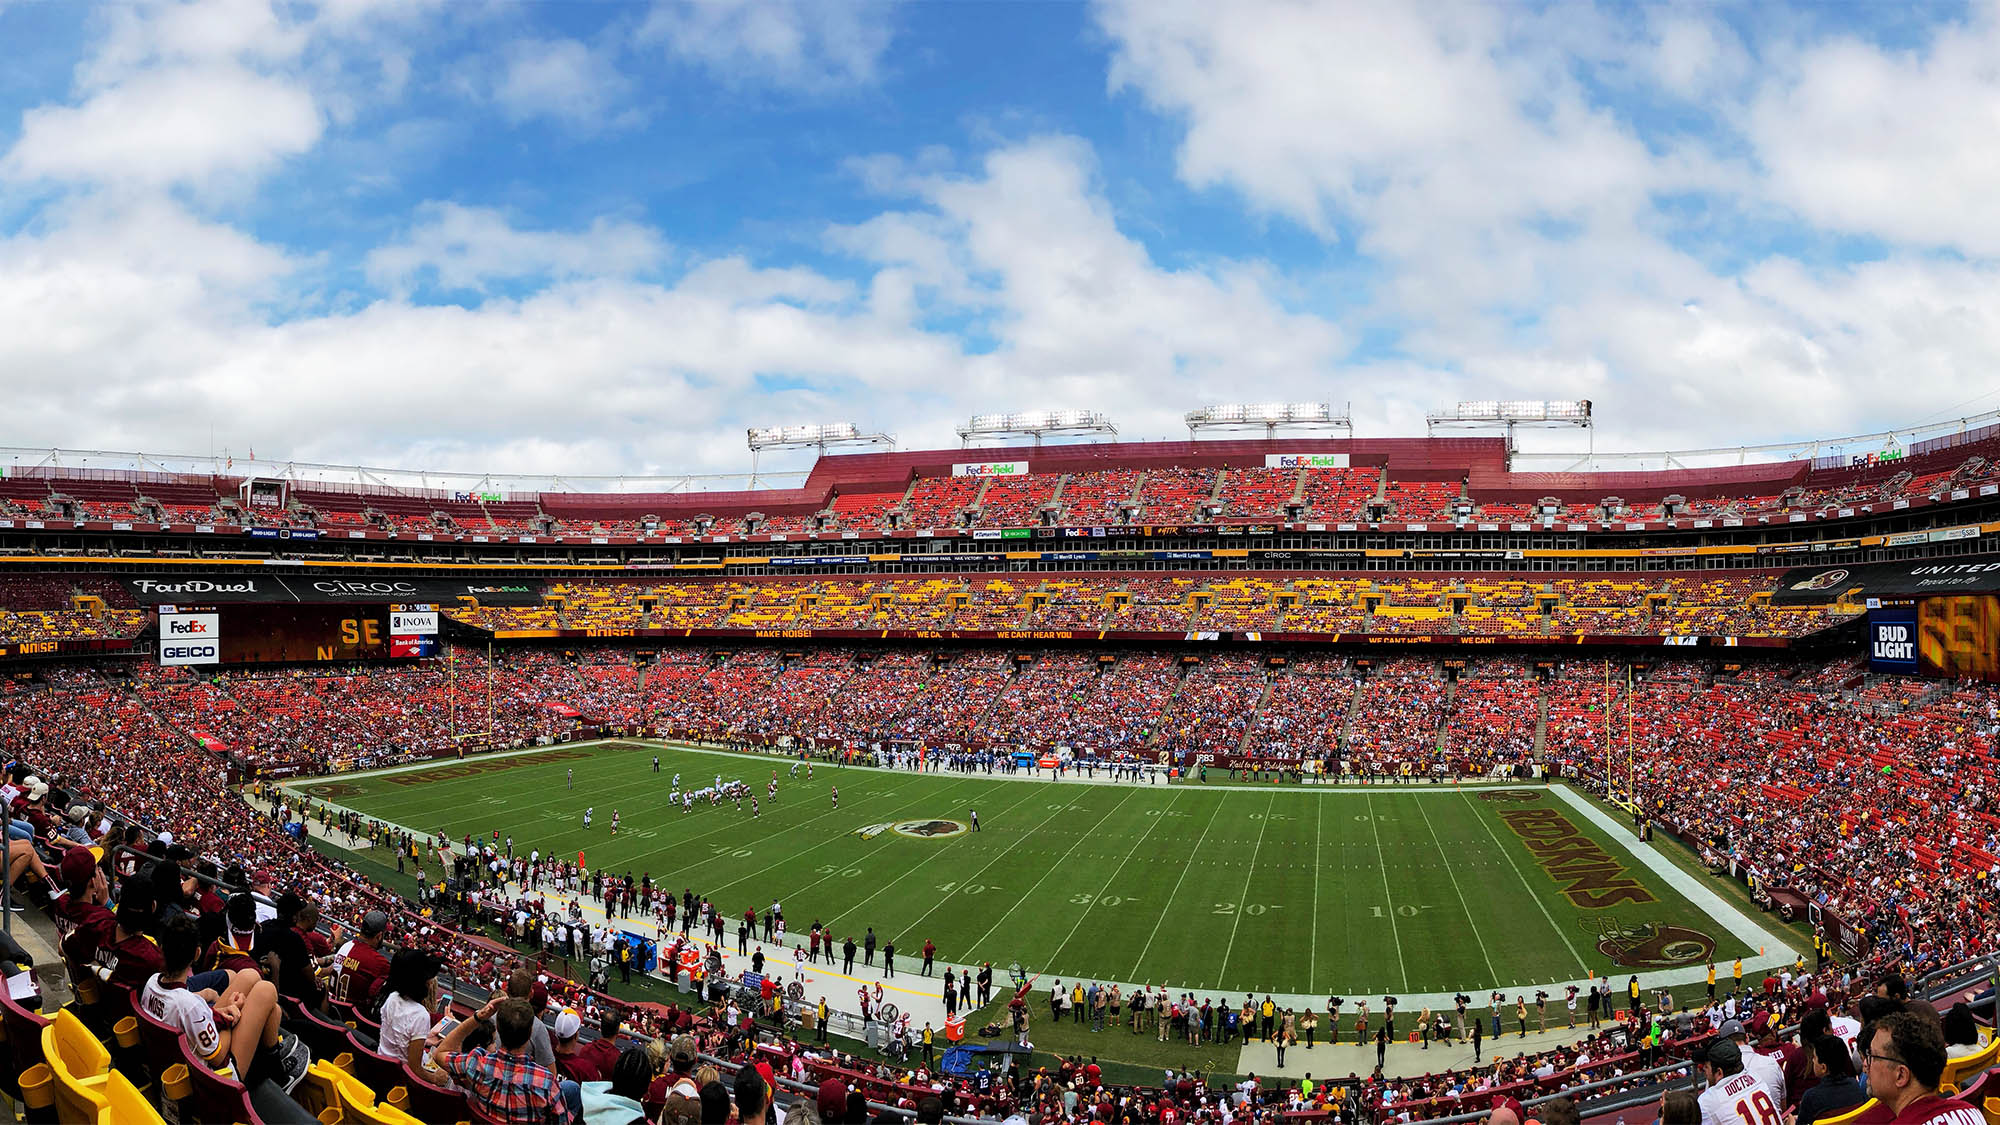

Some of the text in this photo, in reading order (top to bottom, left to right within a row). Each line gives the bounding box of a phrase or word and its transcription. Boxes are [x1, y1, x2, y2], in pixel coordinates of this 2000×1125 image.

[1280, 456, 1334, 466] FedExField
[1853, 448, 1902, 466] FedExField
[966, 464, 1014, 475] FedExField
[455, 492, 502, 500] FedExField
[1065, 528, 1089, 537] FedEx
[1910, 562, 2000, 575] UNITED
[133, 580, 258, 594] FanDuel
[467, 586, 529, 594] FedExField
[170, 620, 206, 634] FedEx
[403, 617, 432, 627] INOVA
[756, 630, 812, 638] MAKE NOISE!
[917, 631, 929, 639] WE
[997, 631, 1072, 639] WE CANT HEAR YOU
[1879, 626, 1908, 642] BUD
[163, 646, 215, 658] GEICO
[1874, 642, 1914, 659] LIGHT
[380, 751, 595, 786] REDSKINS
[1229, 759, 1244, 768] Hail
[1496, 808, 1661, 909] REDSKINS
[815, 864, 863, 878] 50
[936, 881, 986, 895] 40
[1069, 893, 1123, 907] 30
[1211, 903, 1267, 916] 20
[1367, 904, 1419, 918] 10
[148, 994, 165, 1020] MOSS
[199, 1023, 218, 1048] 89
[957, 1026, 963, 1035] G
[980, 1079, 989, 1089] 12
[1724, 1075, 1756, 1097] DOCTSON
[1736, 1090, 1780, 1125] 18
